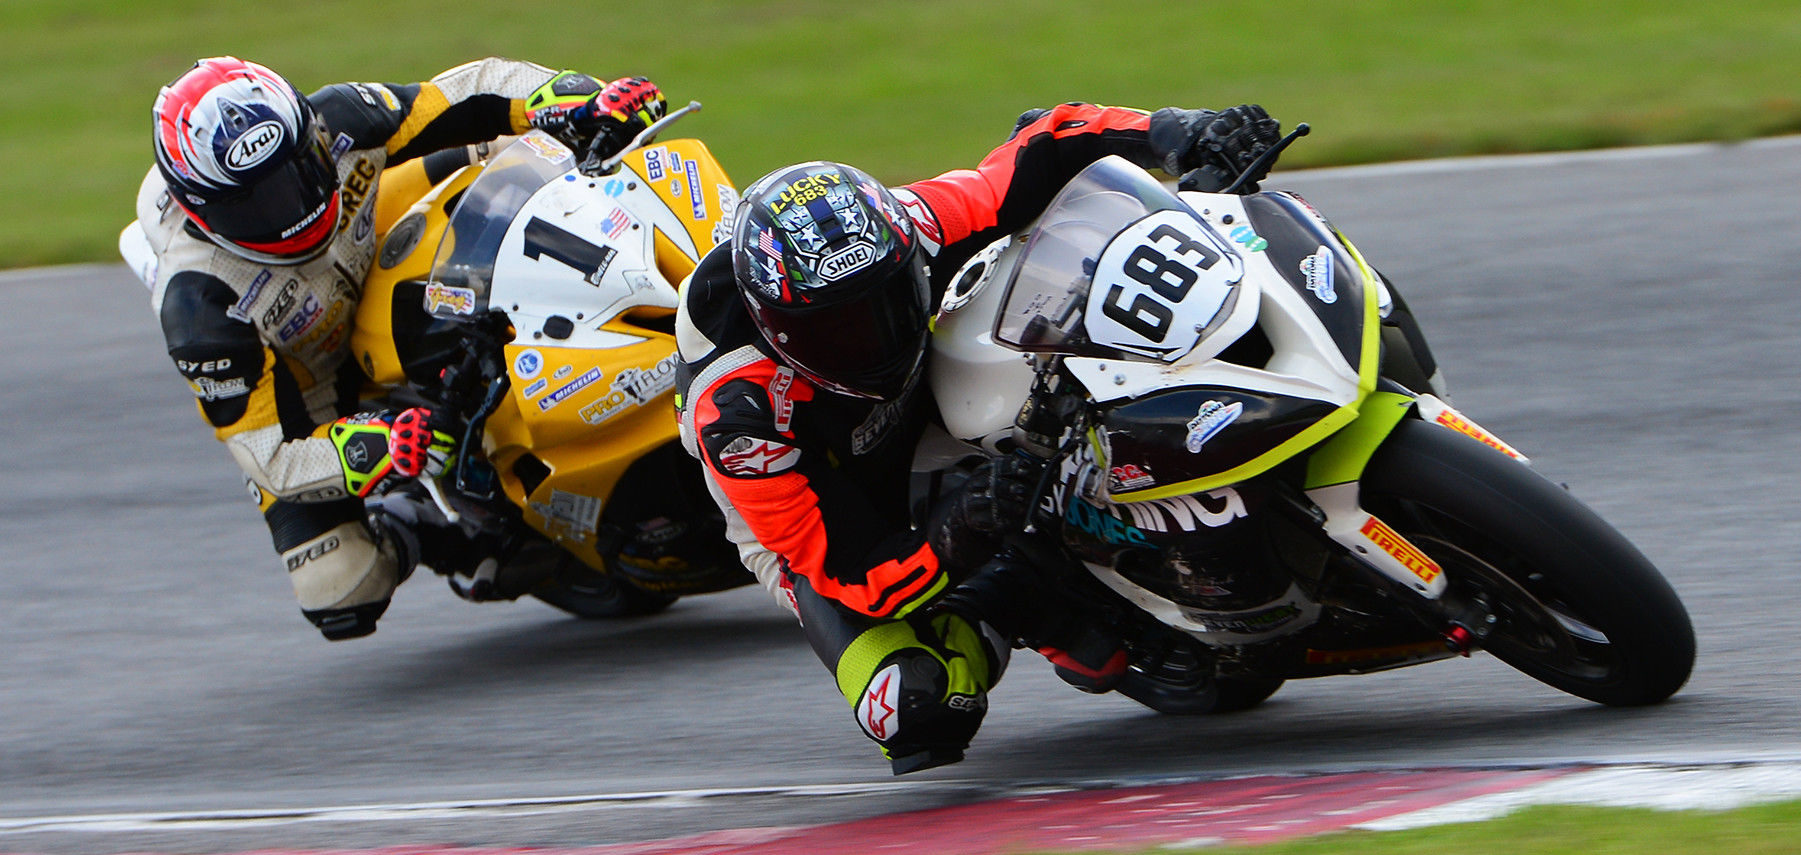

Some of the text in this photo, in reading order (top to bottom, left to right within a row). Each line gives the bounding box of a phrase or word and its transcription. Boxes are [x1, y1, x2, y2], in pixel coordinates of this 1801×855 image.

[236, 126, 275, 166] Arai
[645, 150, 663, 180] EBC
[770, 173, 841, 215] LUCKY
[794, 185, 829, 206] 683
[281, 202, 327, 239] MICHELIN
[523, 215, 618, 288] 1
[826, 247, 869, 276] SHOEI
[1102, 224, 1221, 344] 683
[278, 293, 319, 342] EBC
[178, 358, 231, 373] SYED
[554, 369, 599, 401] MICHELIN
[580, 390, 625, 422] PRO
[1360, 515, 1442, 585] PIRELLI
